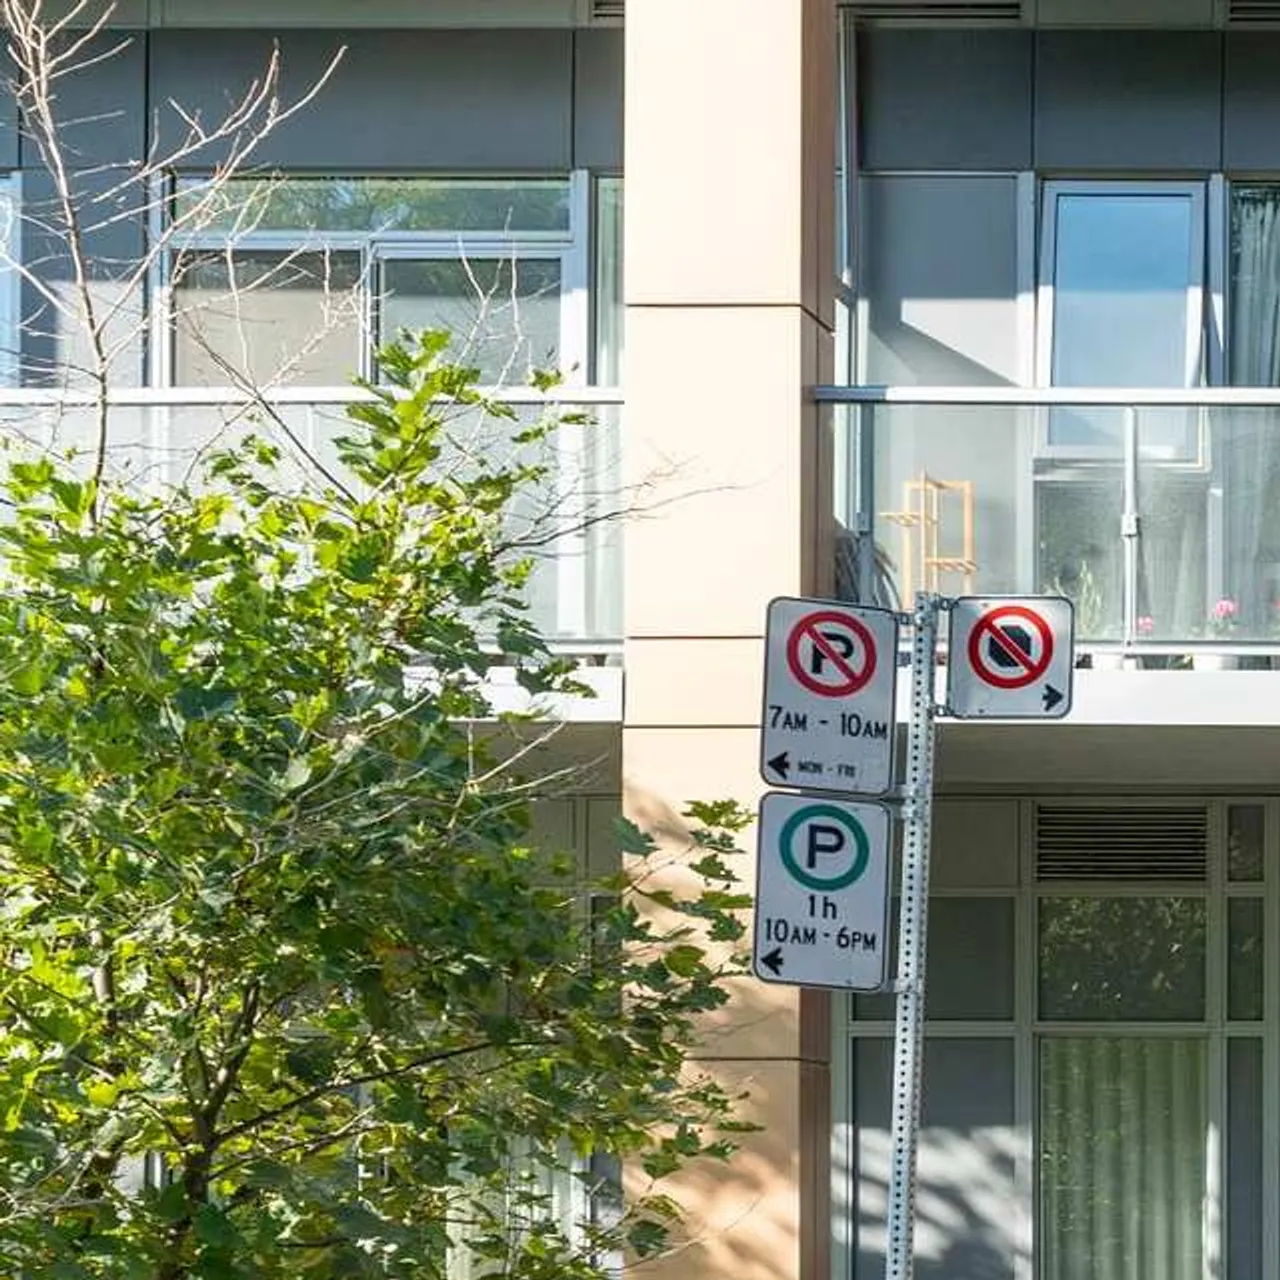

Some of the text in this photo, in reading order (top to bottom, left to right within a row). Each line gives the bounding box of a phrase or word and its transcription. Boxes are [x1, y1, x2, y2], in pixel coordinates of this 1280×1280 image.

[769, 704, 808, 731] 7AM
[841, 711, 888, 739] 10AM
[807, 824, 844, 868] P
[765, 917, 817, 945] 10AM
[837, 926, 877, 951] 6PM
